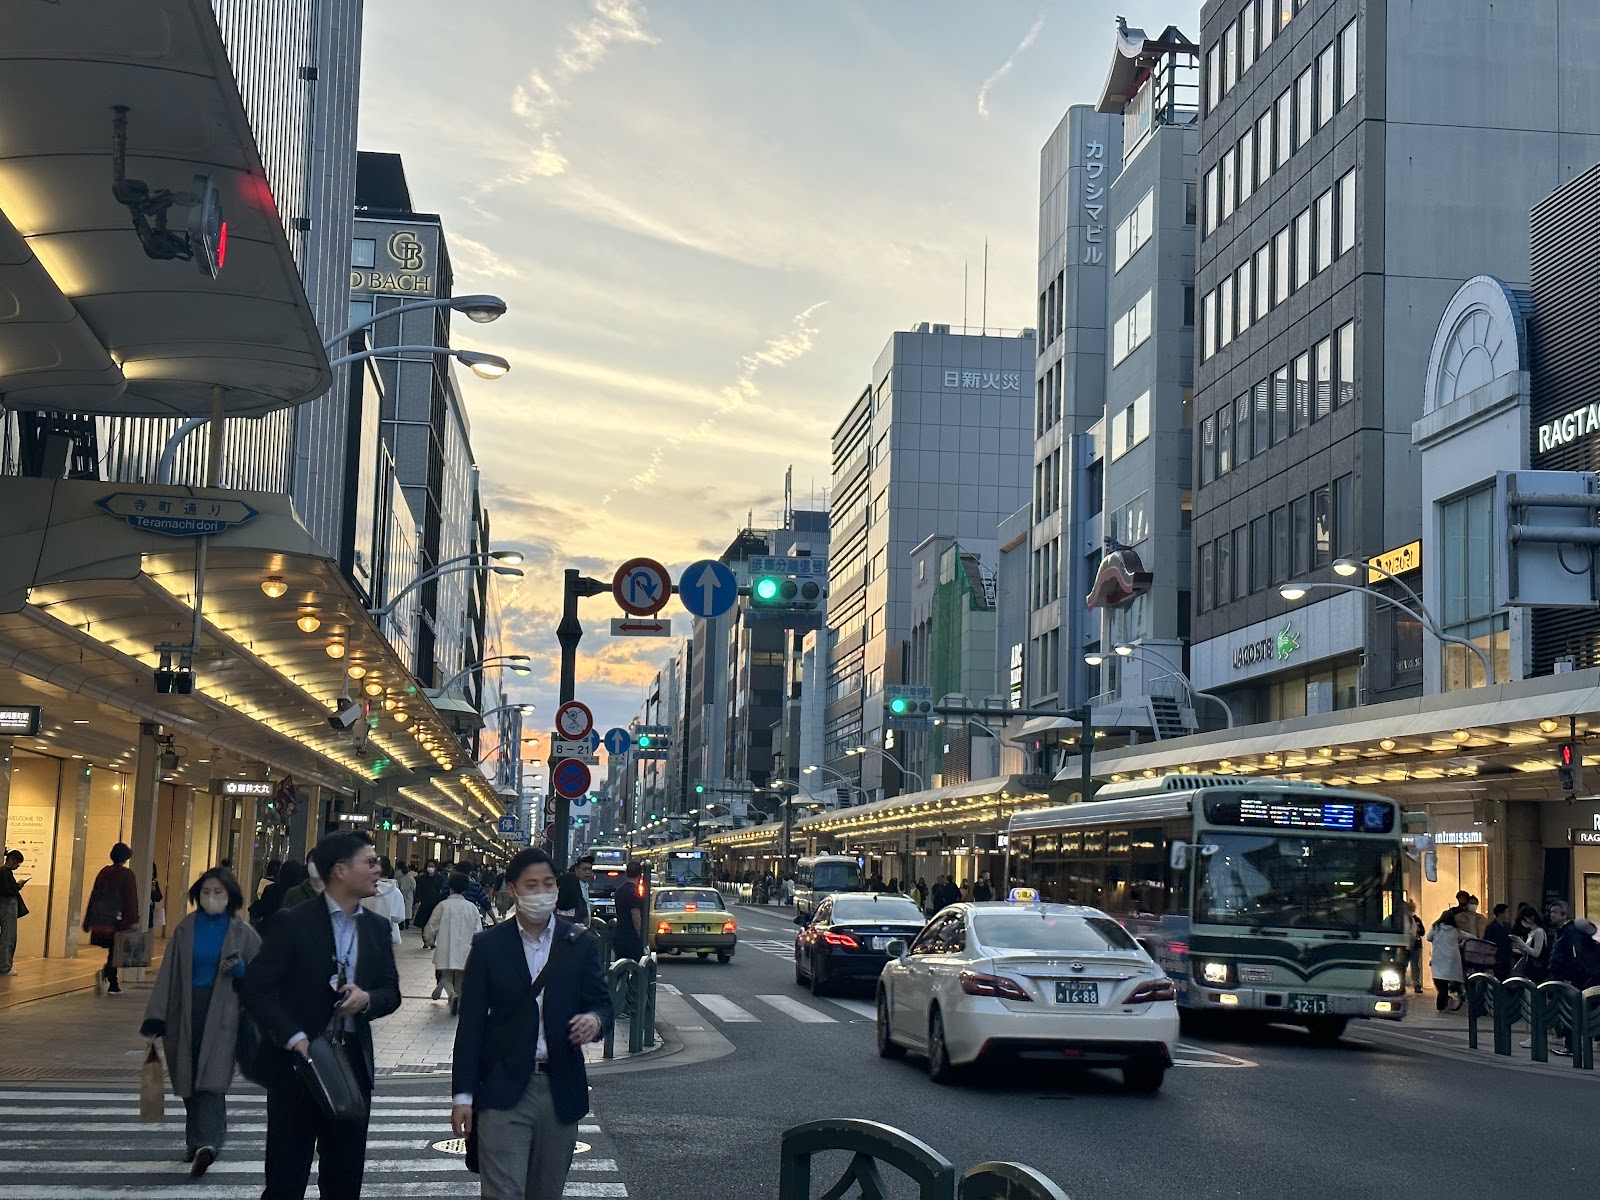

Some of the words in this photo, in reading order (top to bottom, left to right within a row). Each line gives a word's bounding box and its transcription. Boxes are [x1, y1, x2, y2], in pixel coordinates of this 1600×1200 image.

[1083, 140, 1104, 264] カワシマビル
[369, 272, 430, 292] BACH
[944, 371, 1019, 391] 日新火災
[1539, 403, 1600, 453] RAGTA
[134, 499, 221, 517] 寺町通り
[751, 558, 824, 574] 歩車分離信号
[1232, 637, 1274, 669] LACOSTE
[1435, 831, 1482, 843] intimissimi
[1065, 990, 1097, 1003] 16-88
